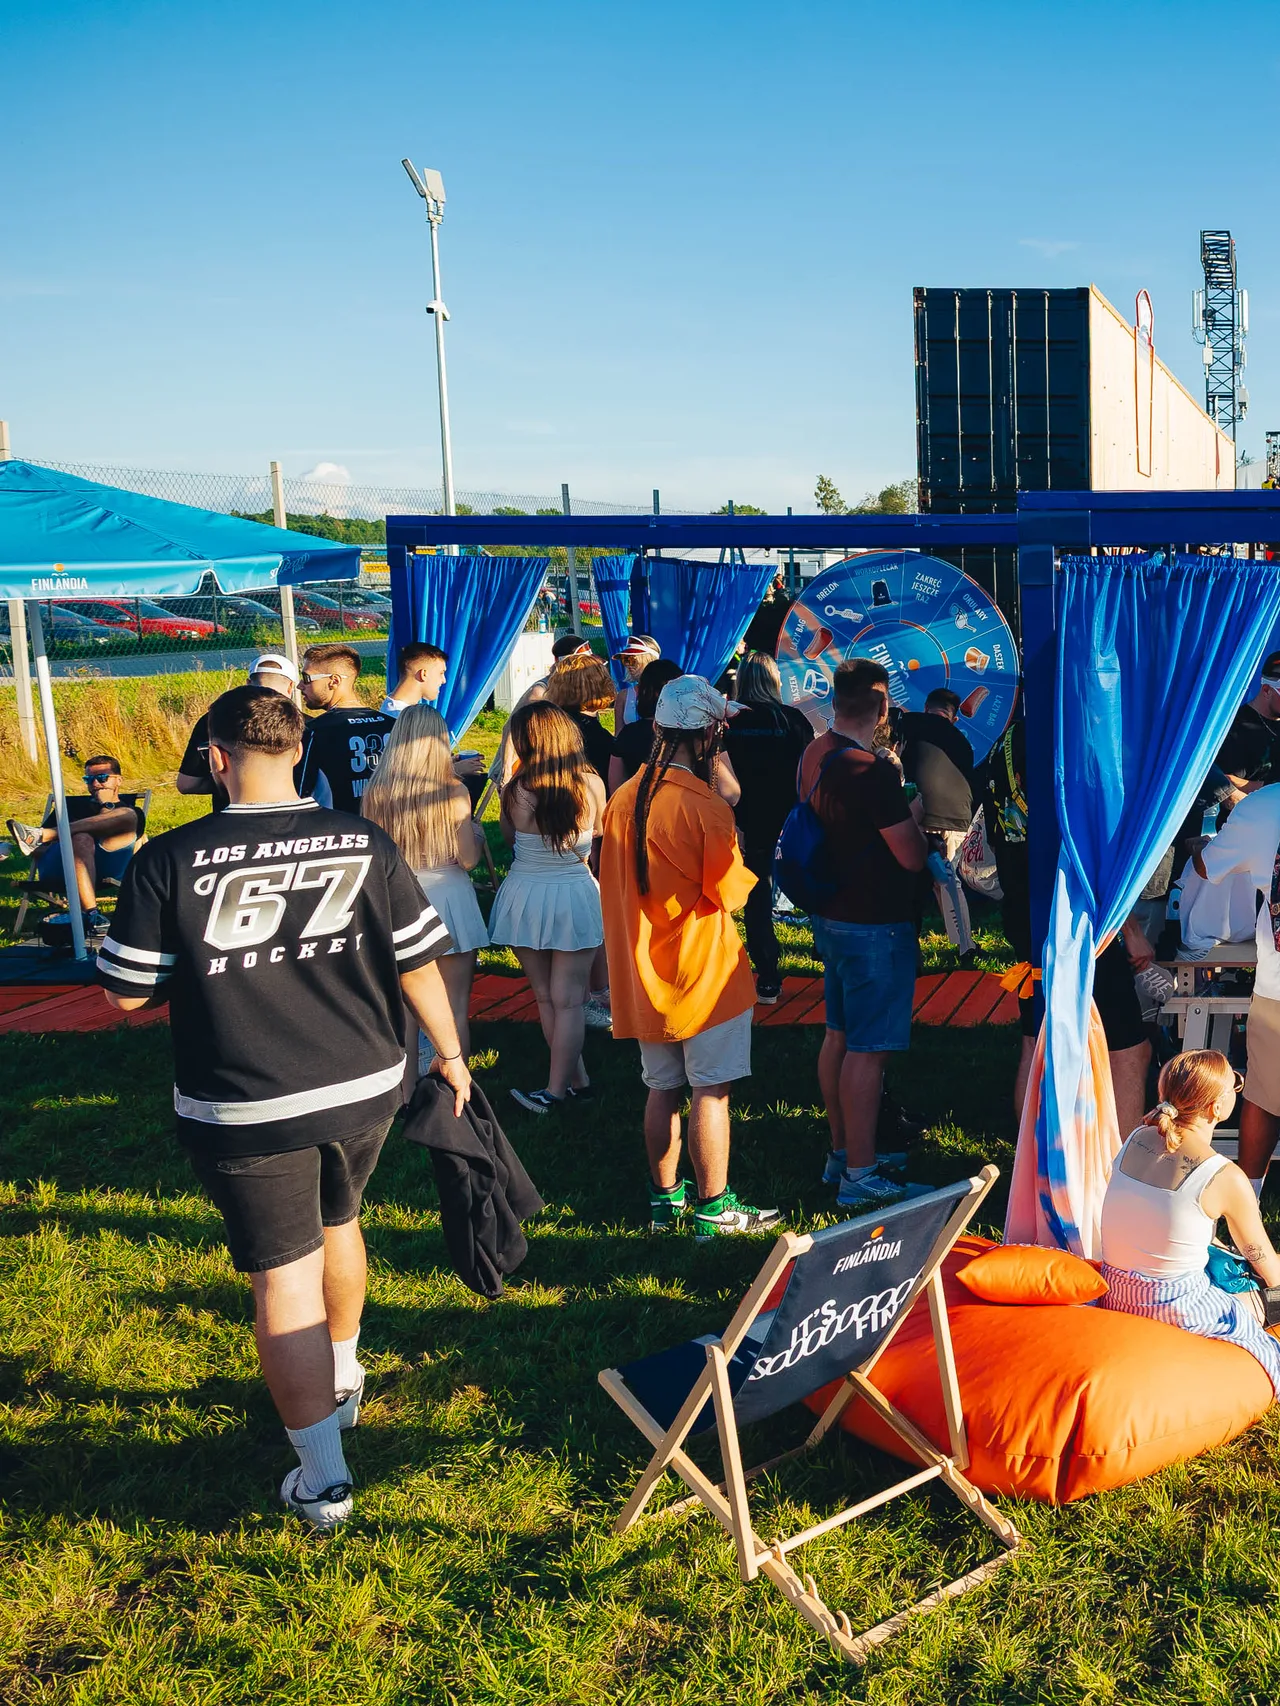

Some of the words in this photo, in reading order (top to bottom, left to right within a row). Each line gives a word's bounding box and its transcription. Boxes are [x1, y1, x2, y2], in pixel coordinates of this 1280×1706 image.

[854, 563, 899, 577] WORKOPLECAK
[915, 572, 943, 588] ZAKRĘĆ
[31, 577, 89, 591] FINLANDIA
[816, 581, 840, 602] BRELOK
[911, 582, 940, 597] JESZCZE
[915, 593, 930, 605] RAZ
[962, 593, 989, 622] OKULARY
[789, 631, 802, 651] LAZY
[798, 618, 807, 634] BAG
[992, 644, 1005, 671] DASZEK
[869, 643, 910, 708] FINLANDIA
[789, 675, 801, 702] DASZEK
[993, 694, 1004, 713] LAZY
[986, 711, 998, 727] BAG
[192, 844, 247, 868] LOS
[252, 834, 370, 860] ANGELES
[832, 1239, 902, 1275] FINLANDIA
